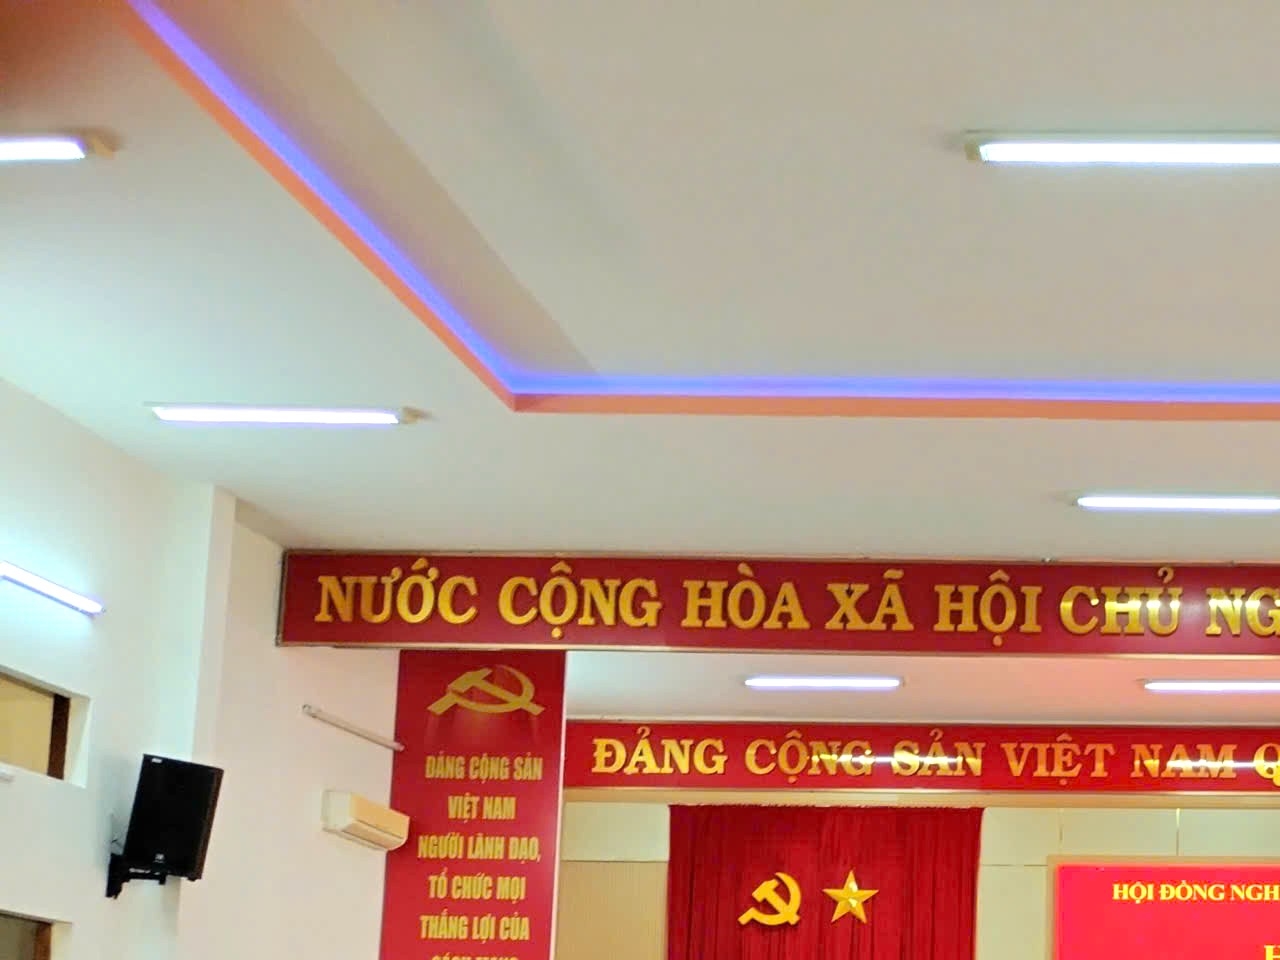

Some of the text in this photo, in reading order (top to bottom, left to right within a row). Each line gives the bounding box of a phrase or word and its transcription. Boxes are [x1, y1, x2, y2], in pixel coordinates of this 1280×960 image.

[317, 559, 476, 624] NƯỚC
[499, 563, 660, 638] CỘNG
[682, 564, 808, 628] HÒA
[825, 570, 924, 631] XÃ
[935, 571, 1040, 644] HỘI
[1059, 566, 1183, 634] CHỦ
[592, 727, 728, 776] ĐẢNG
[746, 733, 878, 782] CỘNG
[889, 728, 983, 777] SẢN
[1002, 733, 1114, 784] VIỆT
[1130, 744, 1239, 778] NAM
[1113, 882, 1153, 904] HỘI
